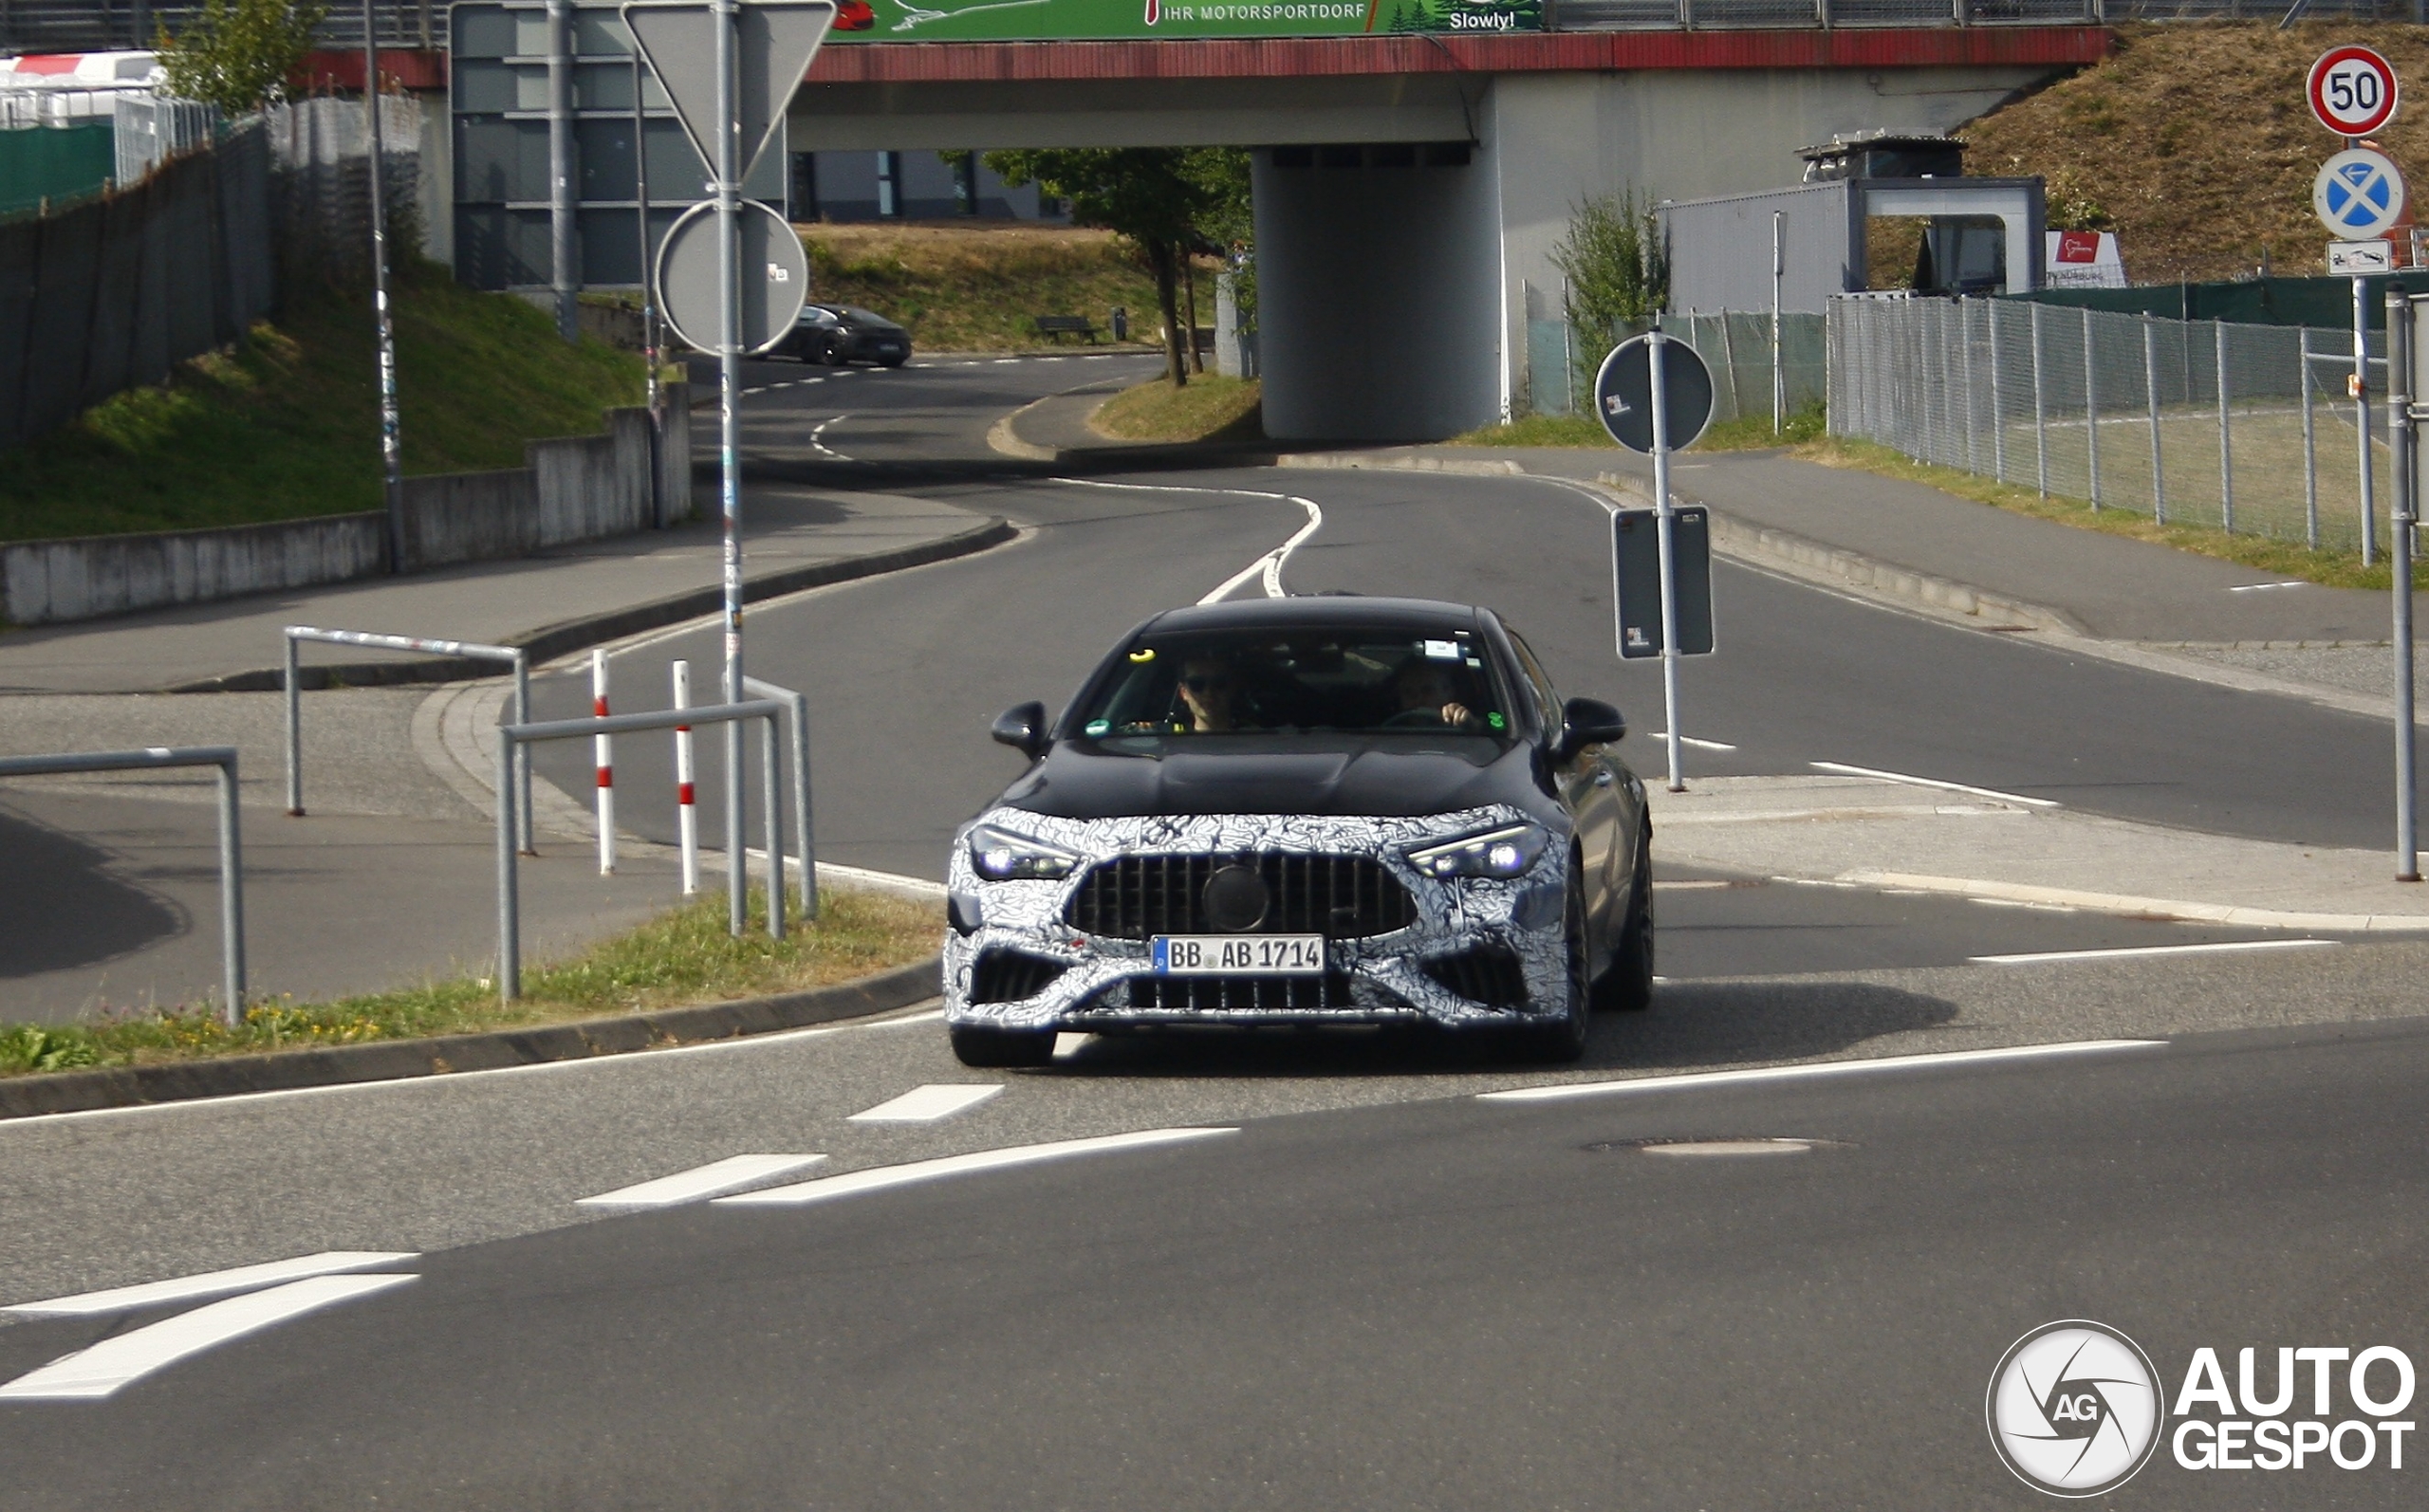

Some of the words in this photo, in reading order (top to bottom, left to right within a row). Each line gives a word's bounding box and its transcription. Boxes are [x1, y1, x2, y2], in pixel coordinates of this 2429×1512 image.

[1164, 7, 1194, 20] IHR
[1200, 4, 1365, 20] MOTORSPORTDORF
[1450, 11, 1515, 30] Slowly!
[2330, 71, 2378, 111] 50
[1170, 941, 1202, 968] BB
[1221, 941, 1252, 968] AB
[1258, 940, 1320, 967] 1714
